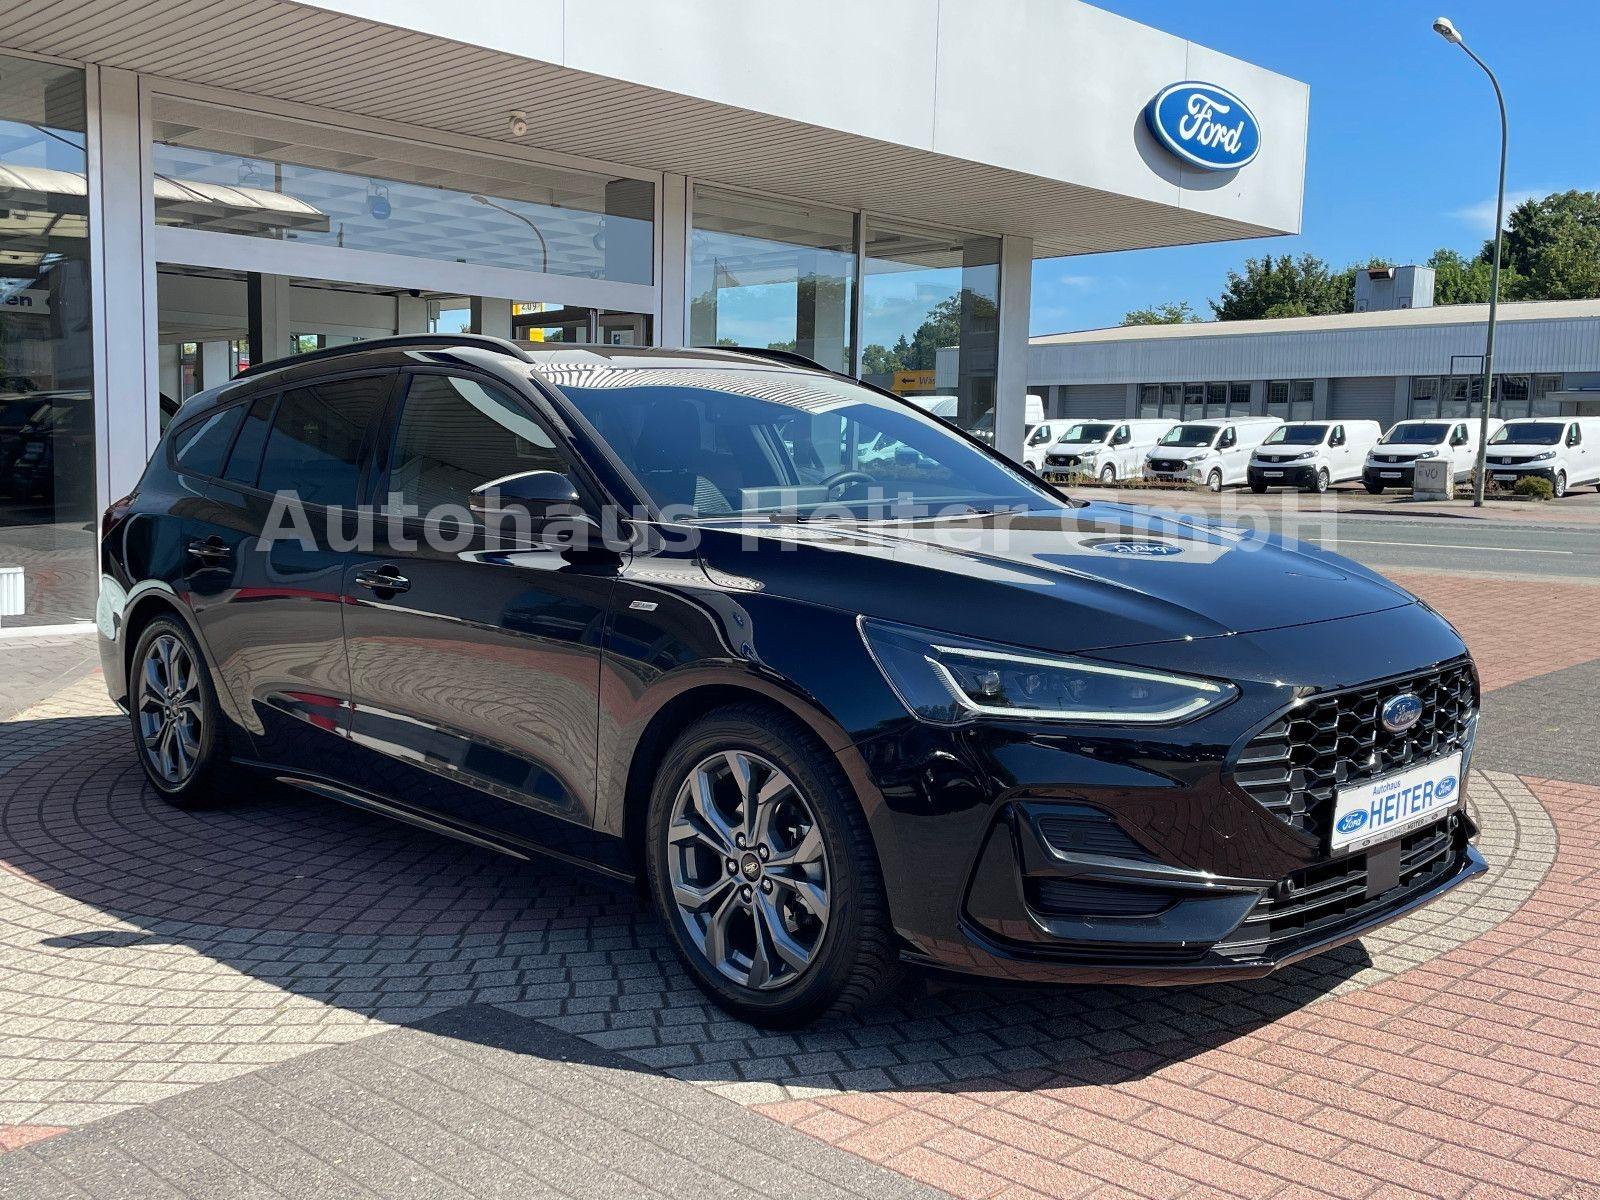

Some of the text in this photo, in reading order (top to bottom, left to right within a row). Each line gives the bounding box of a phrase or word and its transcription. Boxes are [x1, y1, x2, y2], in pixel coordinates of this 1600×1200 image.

[1179, 93, 1245, 155] Ford
[1342, 777, 1454, 831] Ford HEITER Ford
[1372, 780, 1401, 796] Autohaus
